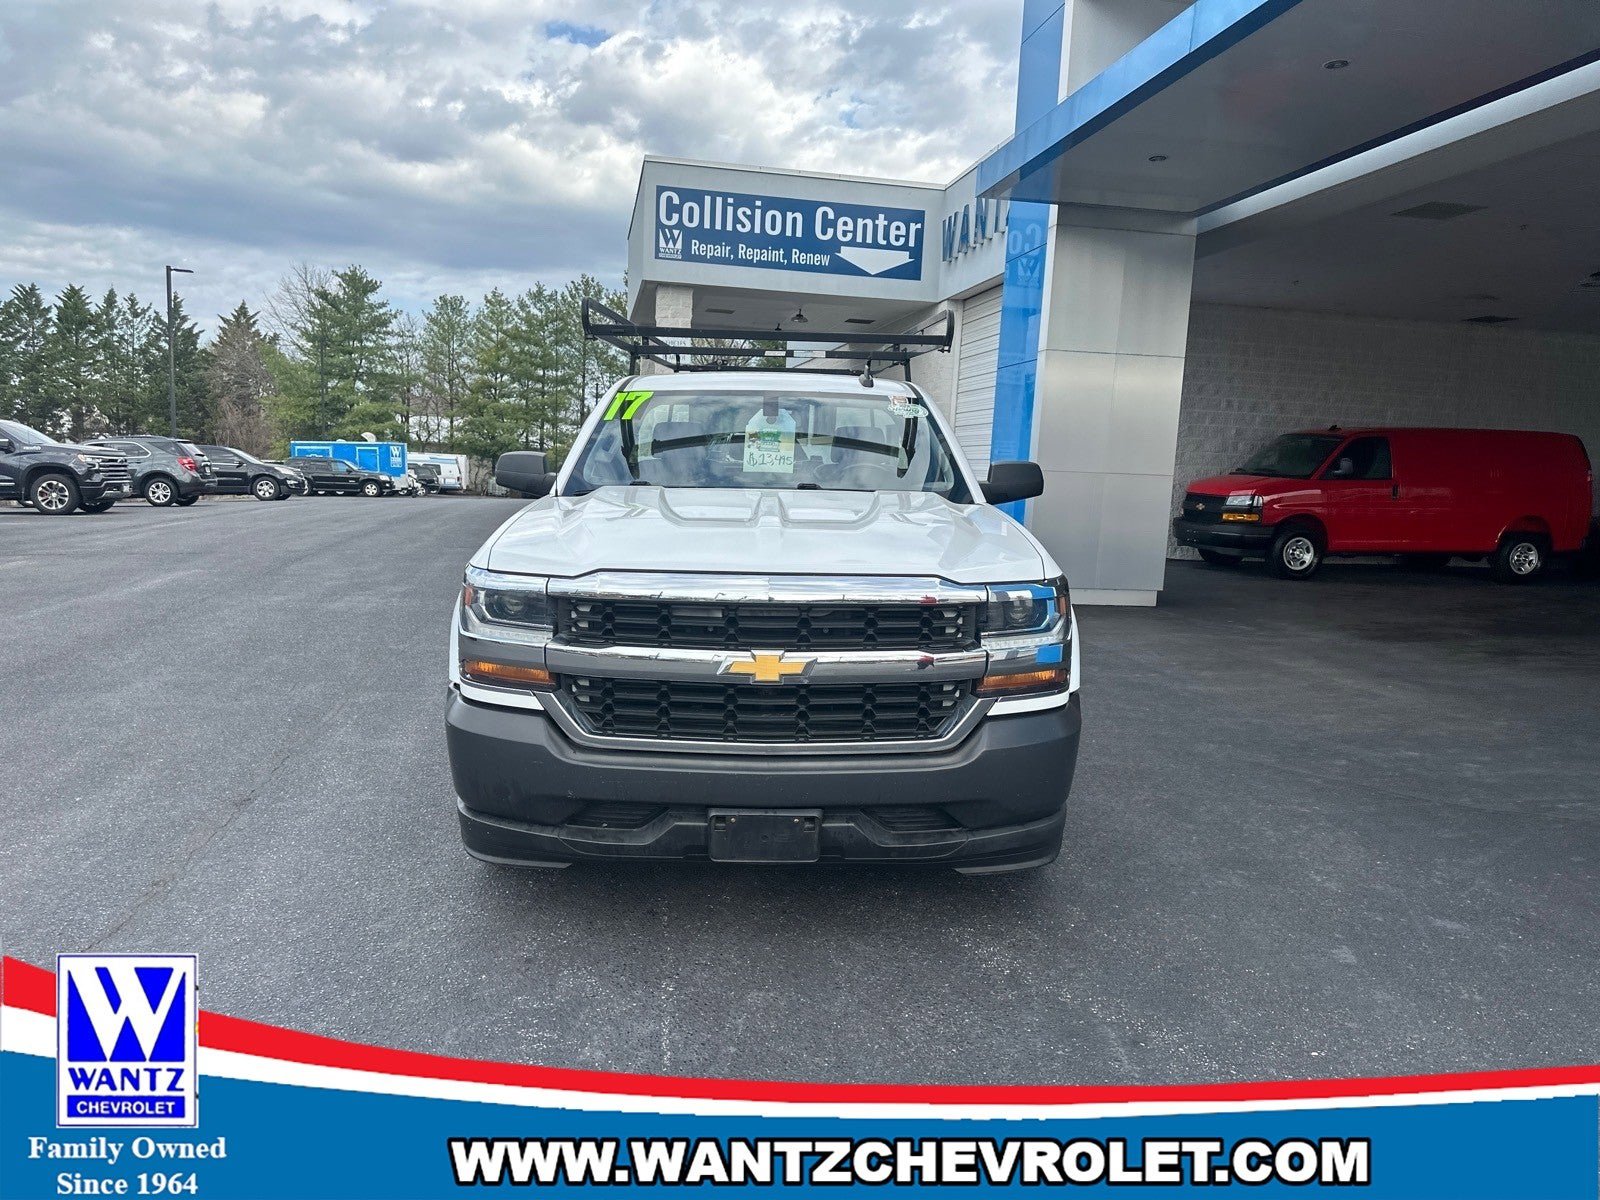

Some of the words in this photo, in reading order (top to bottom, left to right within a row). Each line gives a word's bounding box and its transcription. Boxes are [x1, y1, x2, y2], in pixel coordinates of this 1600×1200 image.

[659, 191, 803, 237] Collision
[815, 206, 922, 247] Center
[691, 239, 734, 260] Repair,
[738, 243, 788, 266] Repaint,
[791, 248, 831, 267] Renew
[603, 391, 654, 421] 17
